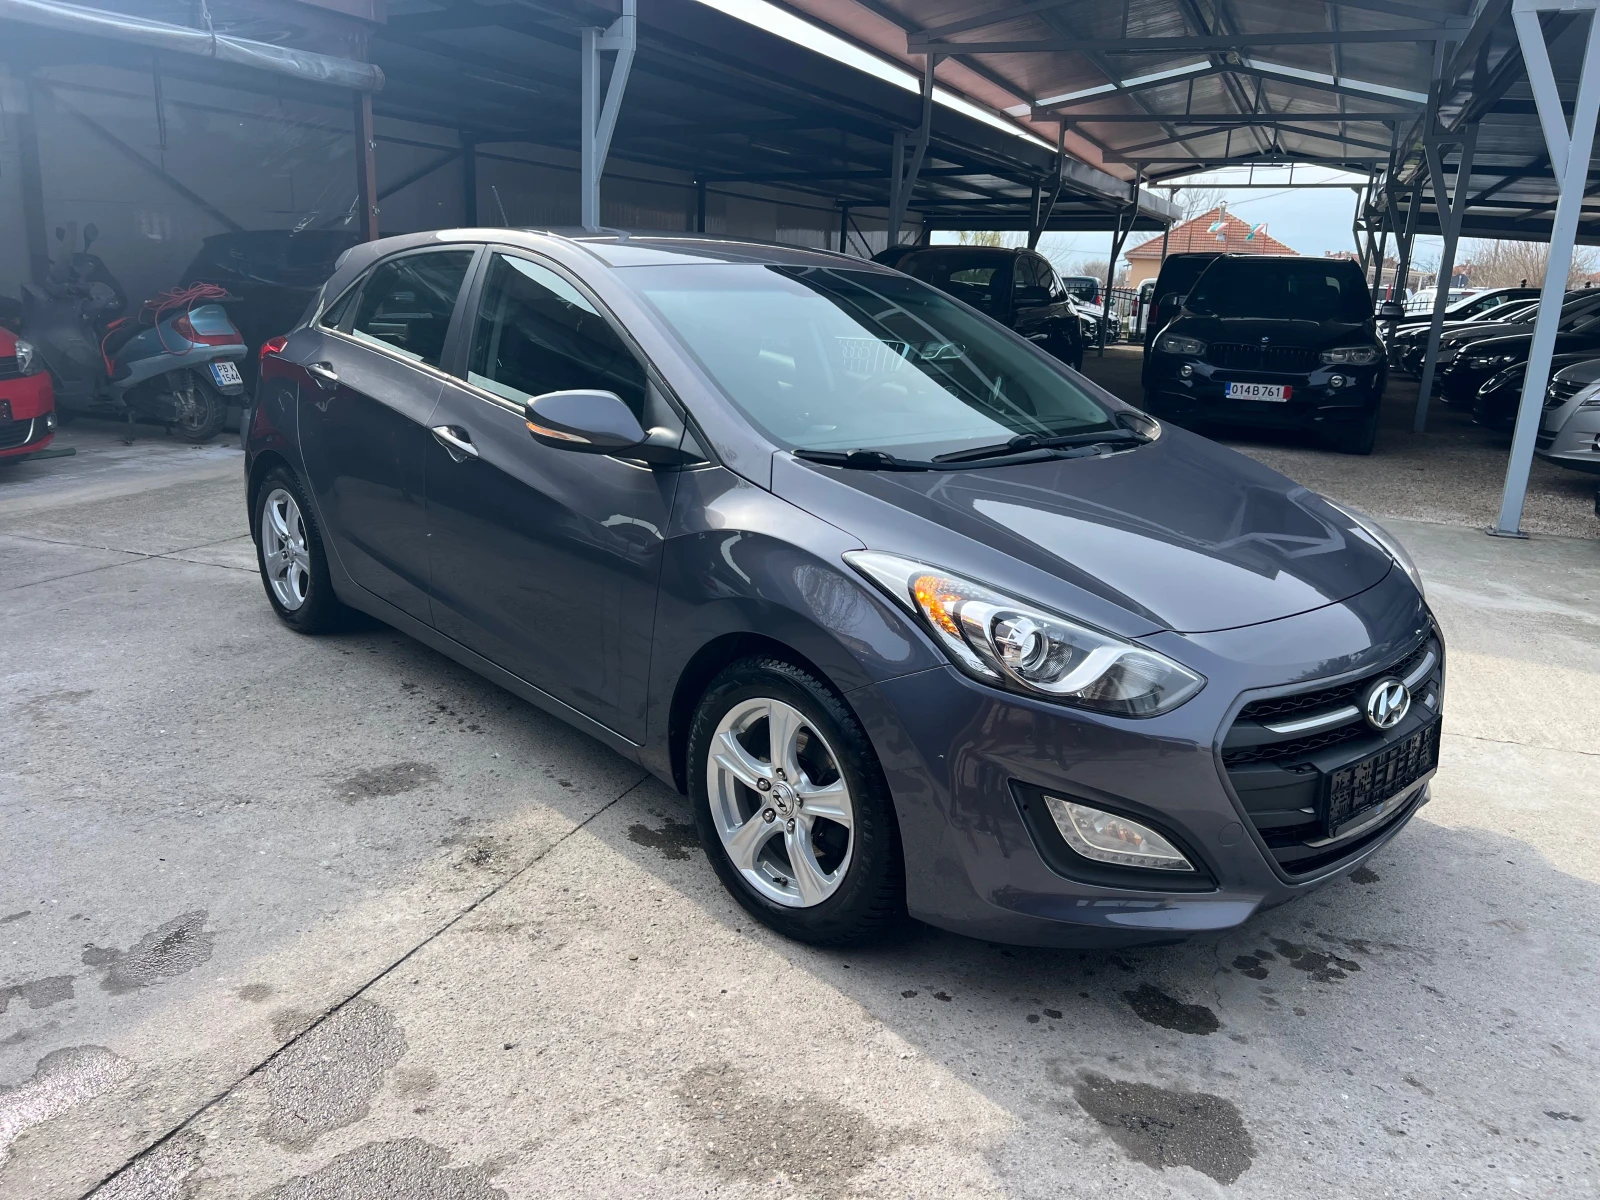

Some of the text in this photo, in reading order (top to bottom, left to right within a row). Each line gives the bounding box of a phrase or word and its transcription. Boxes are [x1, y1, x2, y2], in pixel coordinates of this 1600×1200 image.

[217, 364, 229, 374] PB
[222, 373, 241, 382] 1544
[1231, 384, 1280, 397] 014B761
